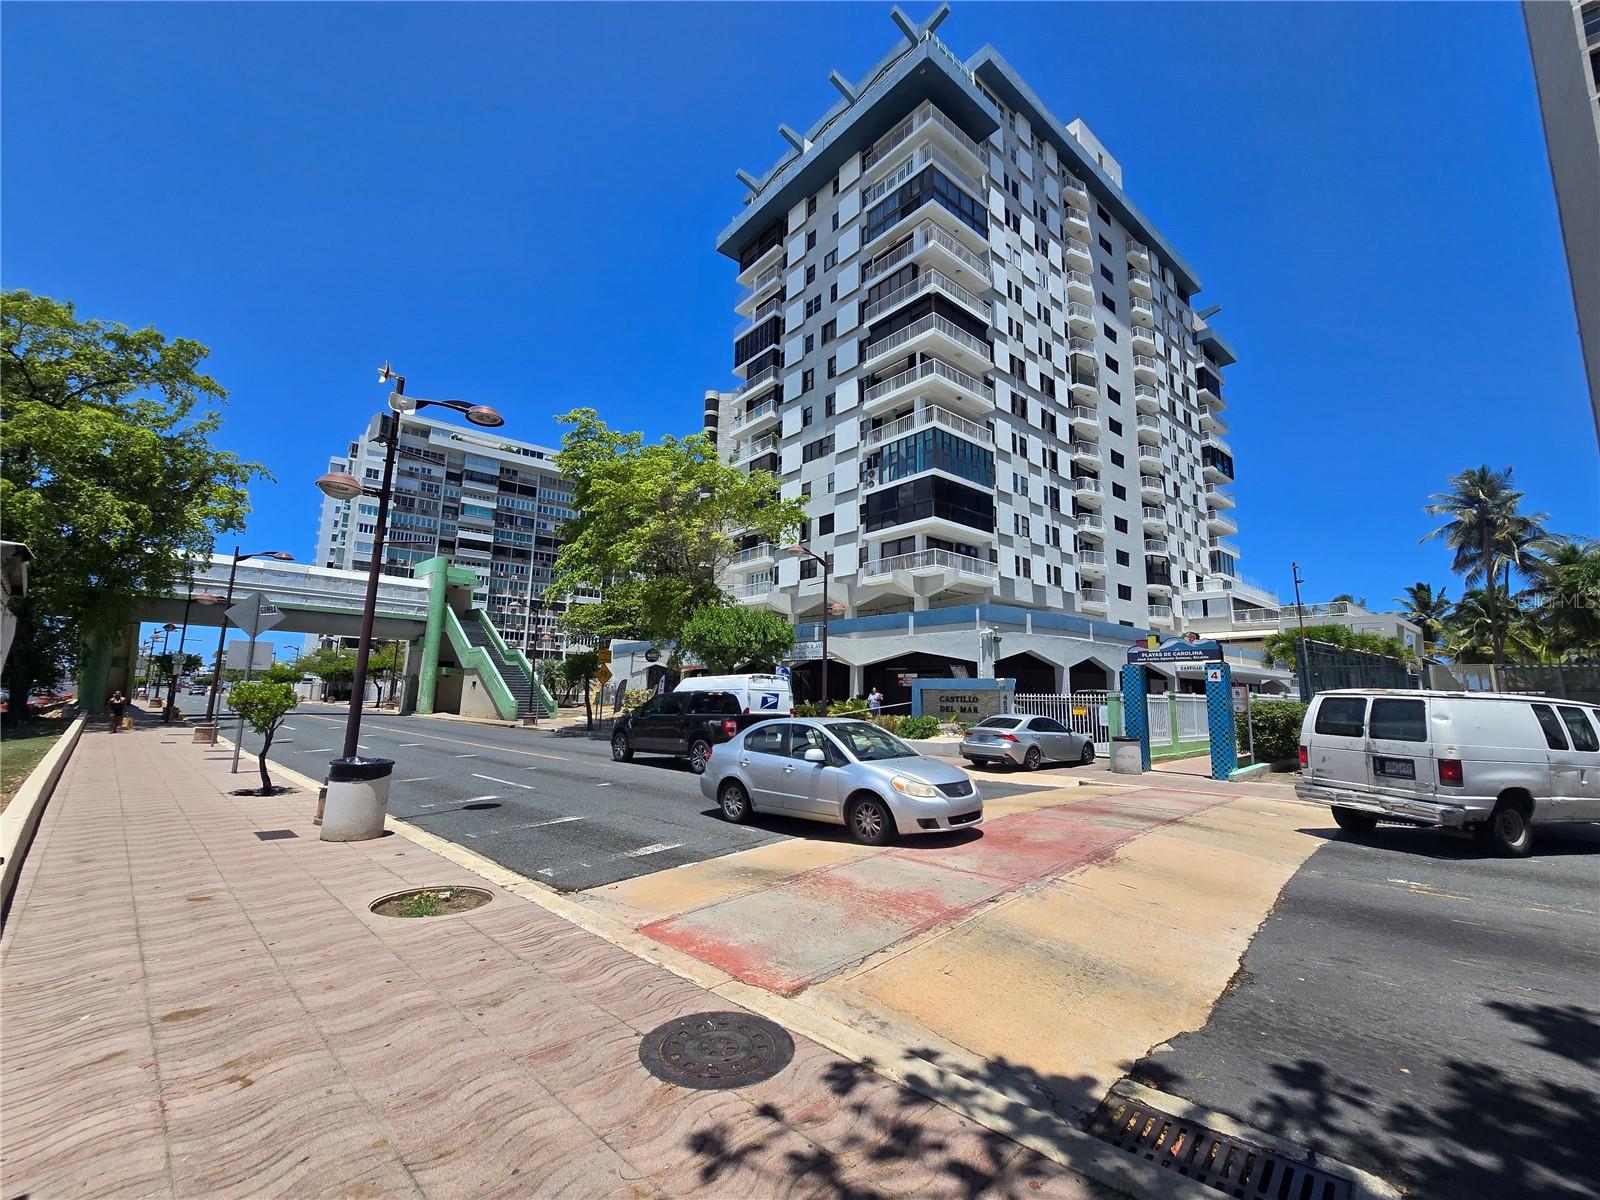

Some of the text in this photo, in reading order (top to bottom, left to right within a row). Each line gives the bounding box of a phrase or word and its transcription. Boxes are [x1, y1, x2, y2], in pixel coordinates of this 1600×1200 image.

[1211, 671, 1218, 680] 4
[939, 695, 979, 704] CASTILLO
[940, 705, 979, 714] DEL MAR
